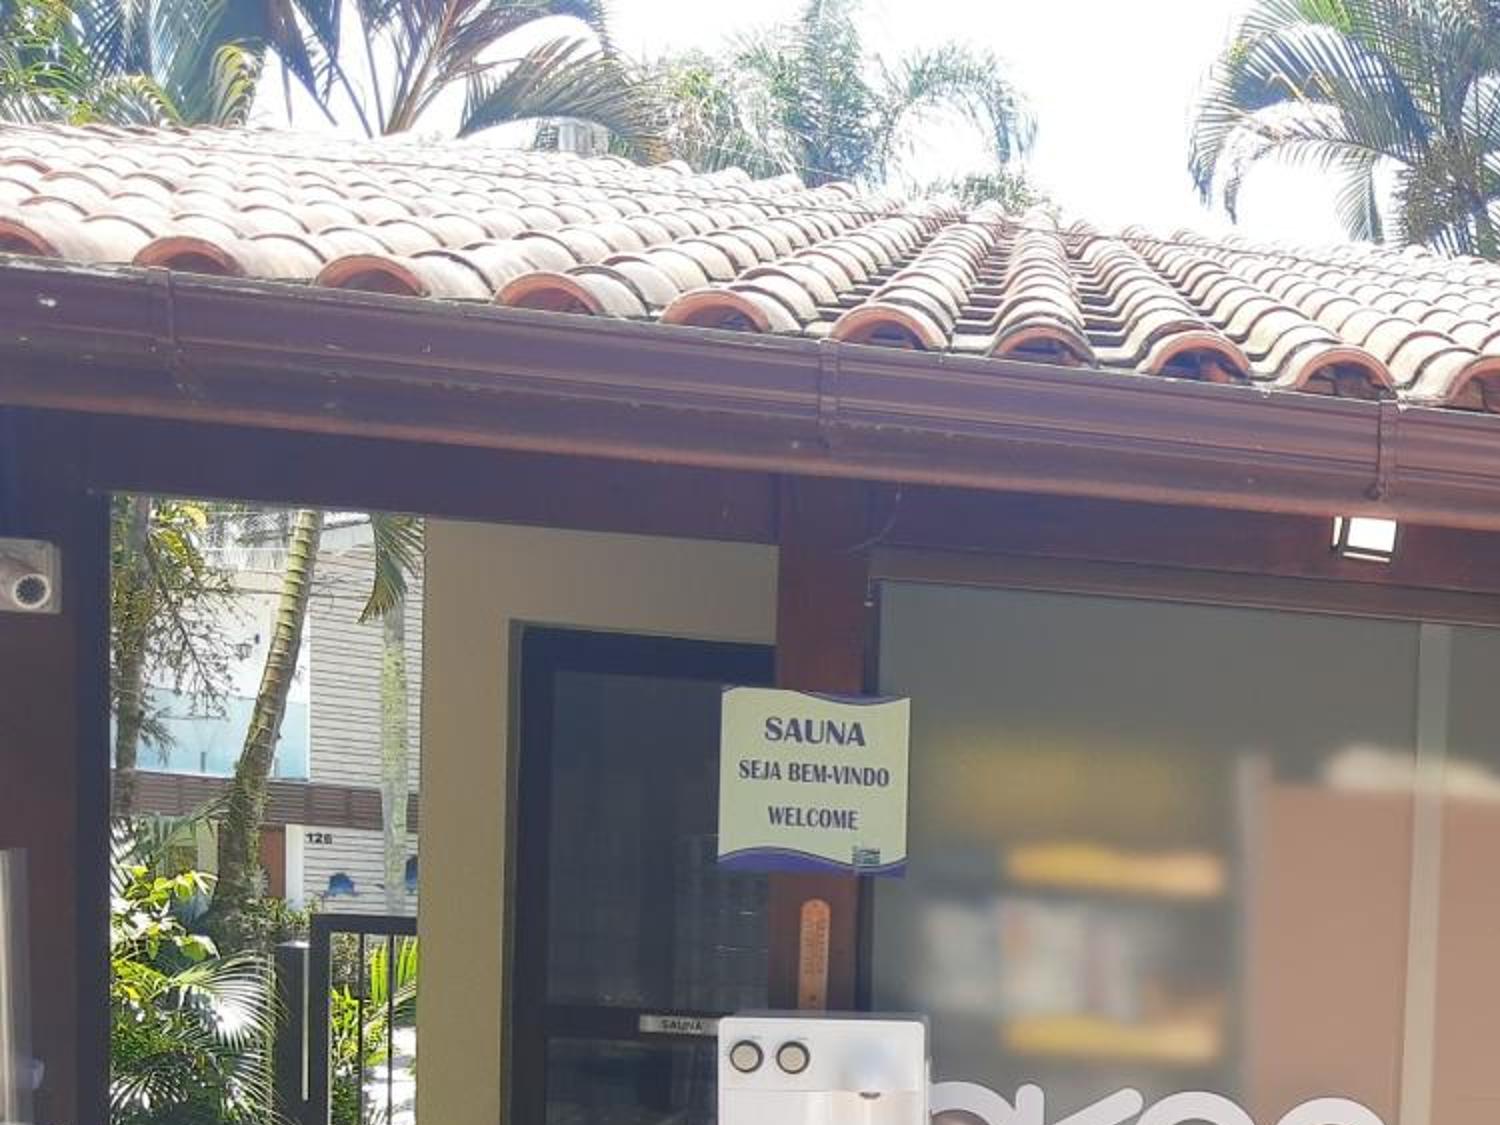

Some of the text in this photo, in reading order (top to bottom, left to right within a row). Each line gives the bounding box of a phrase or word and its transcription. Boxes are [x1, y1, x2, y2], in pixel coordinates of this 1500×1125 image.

[764, 715, 866, 746] SAUNA
[738, 759, 890, 788] SEJA BEM-VINDO
[767, 805, 859, 831] WELCOME
